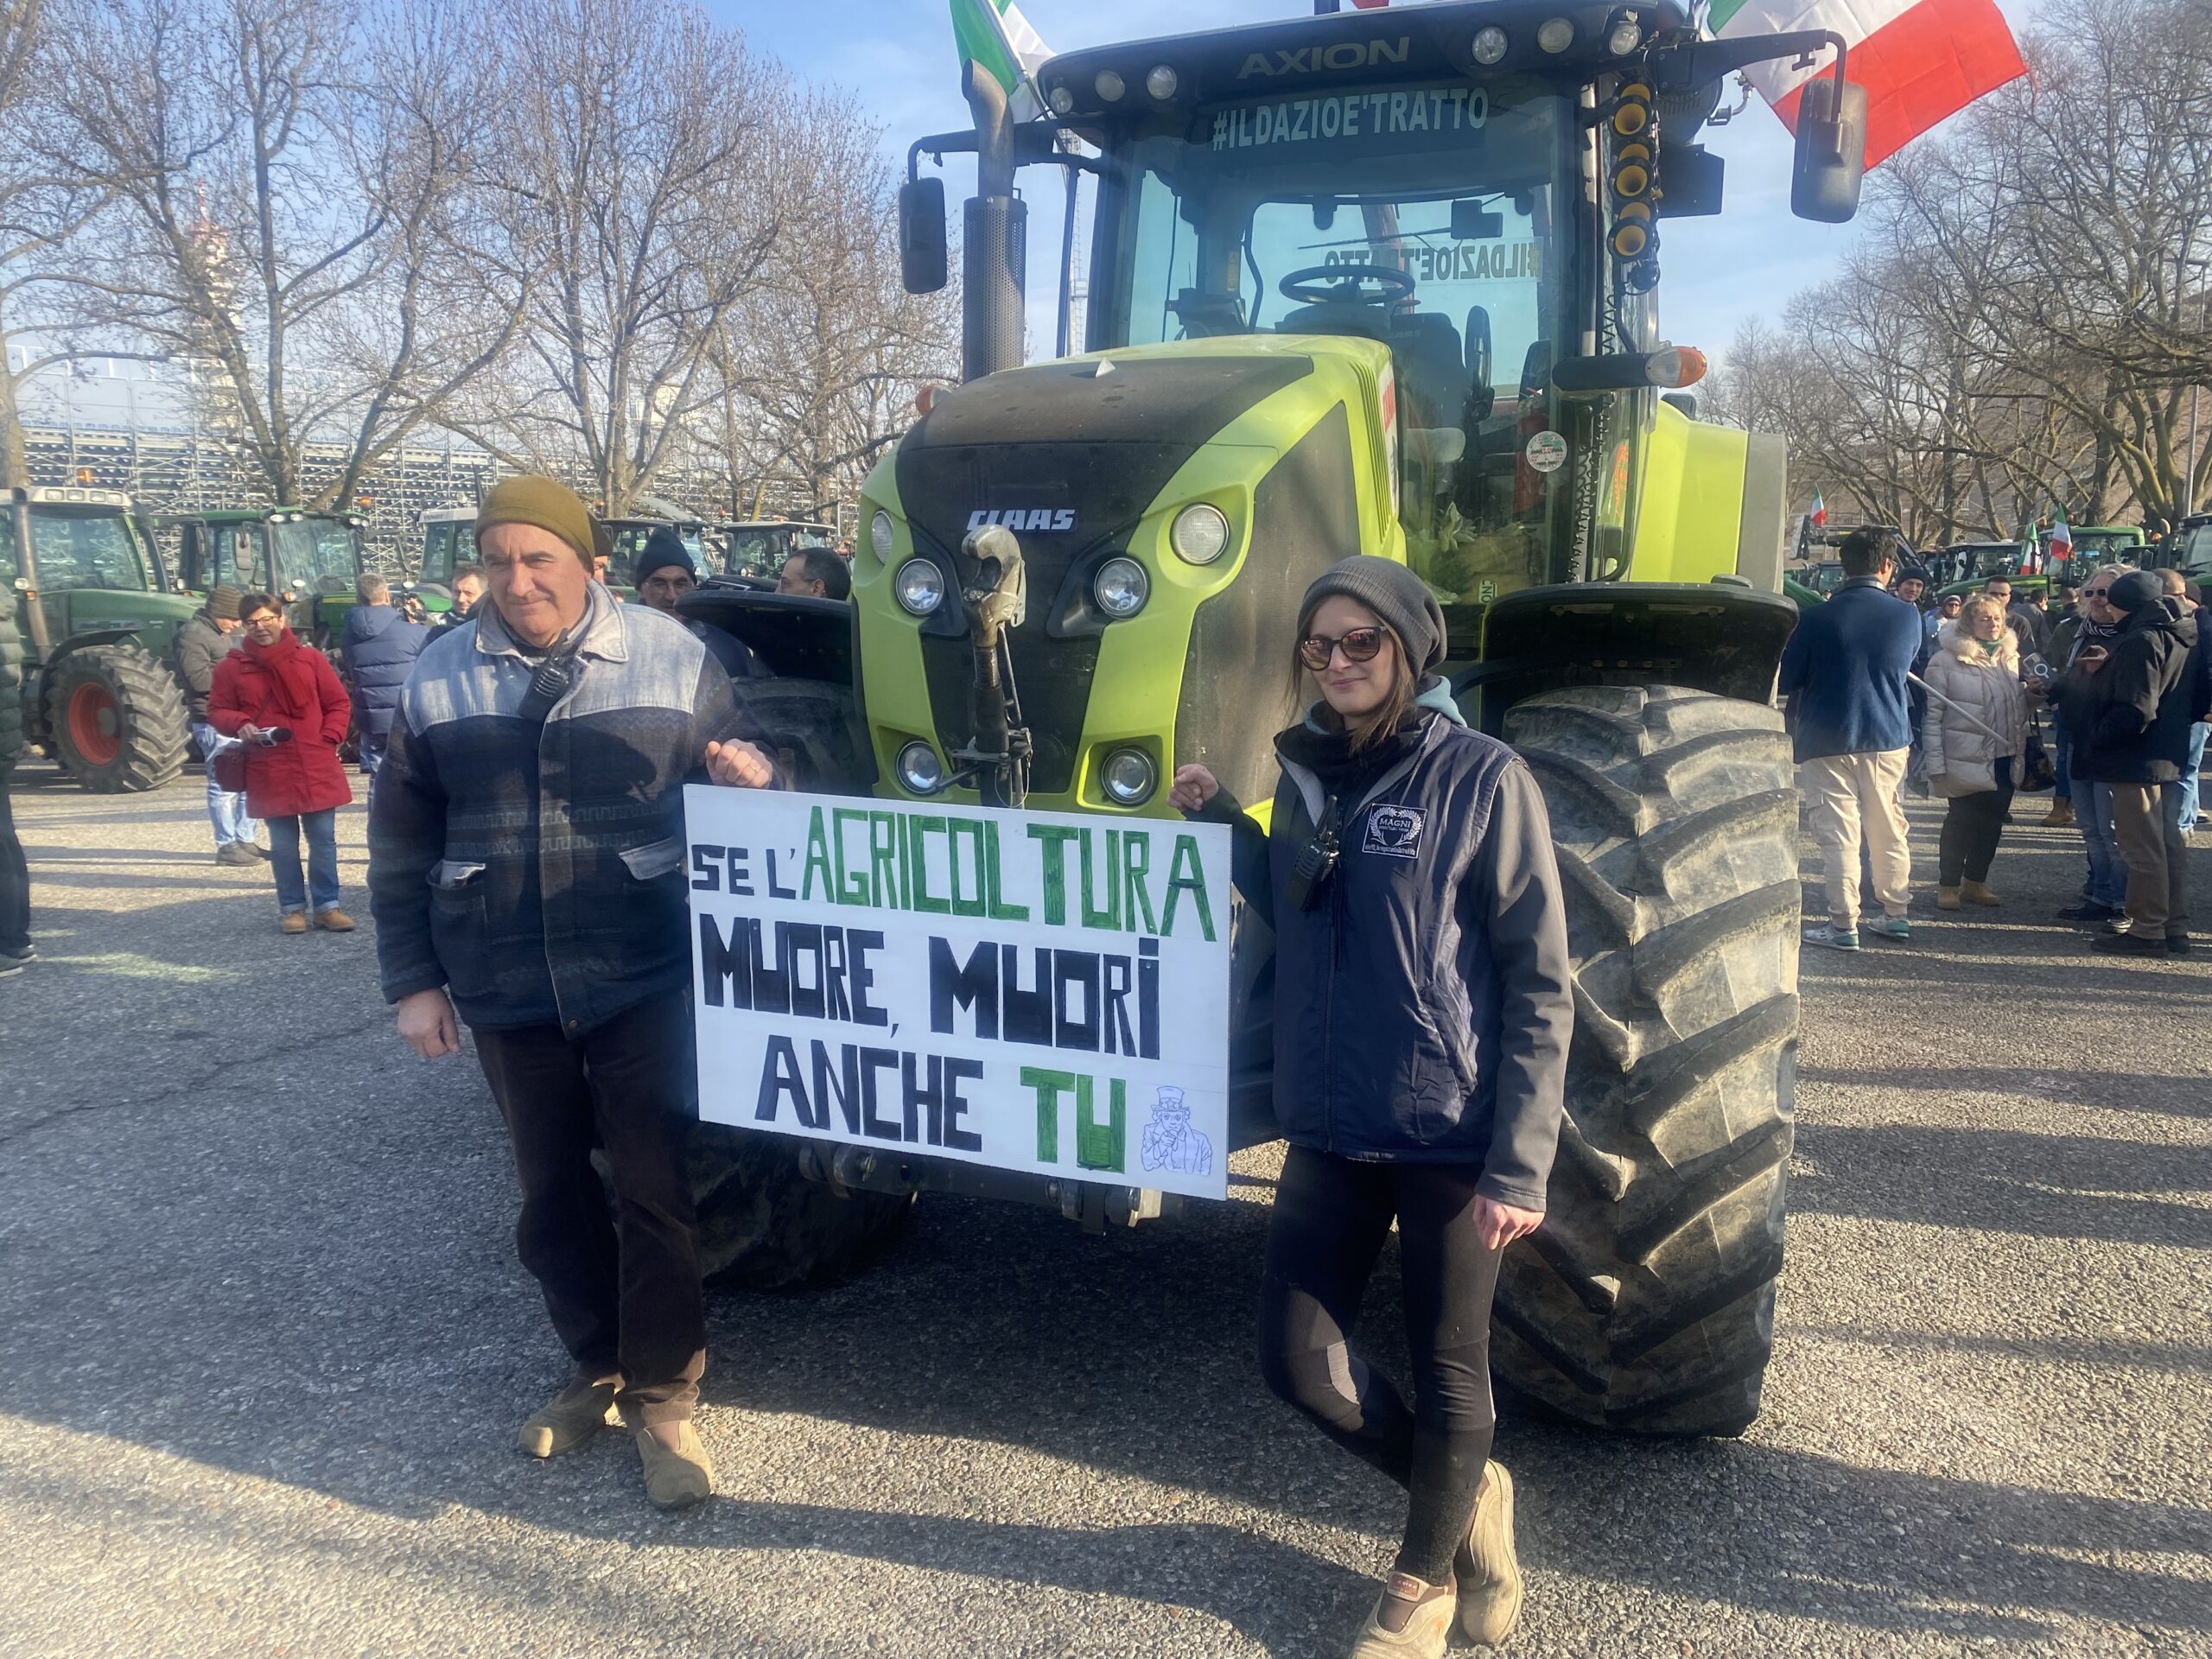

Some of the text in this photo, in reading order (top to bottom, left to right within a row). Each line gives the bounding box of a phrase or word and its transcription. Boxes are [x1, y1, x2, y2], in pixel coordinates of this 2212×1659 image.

[1236, 36, 1410, 80] AXION
[1212, 87, 1489, 151] #ILDAZIOE'TRATTO
[1380, 817, 1411, 829] MAGNI
[691, 844, 755, 896] SE
[700, 912, 899, 1038] MUORE,
[754, 1034, 1127, 1174] ANCHE TU
